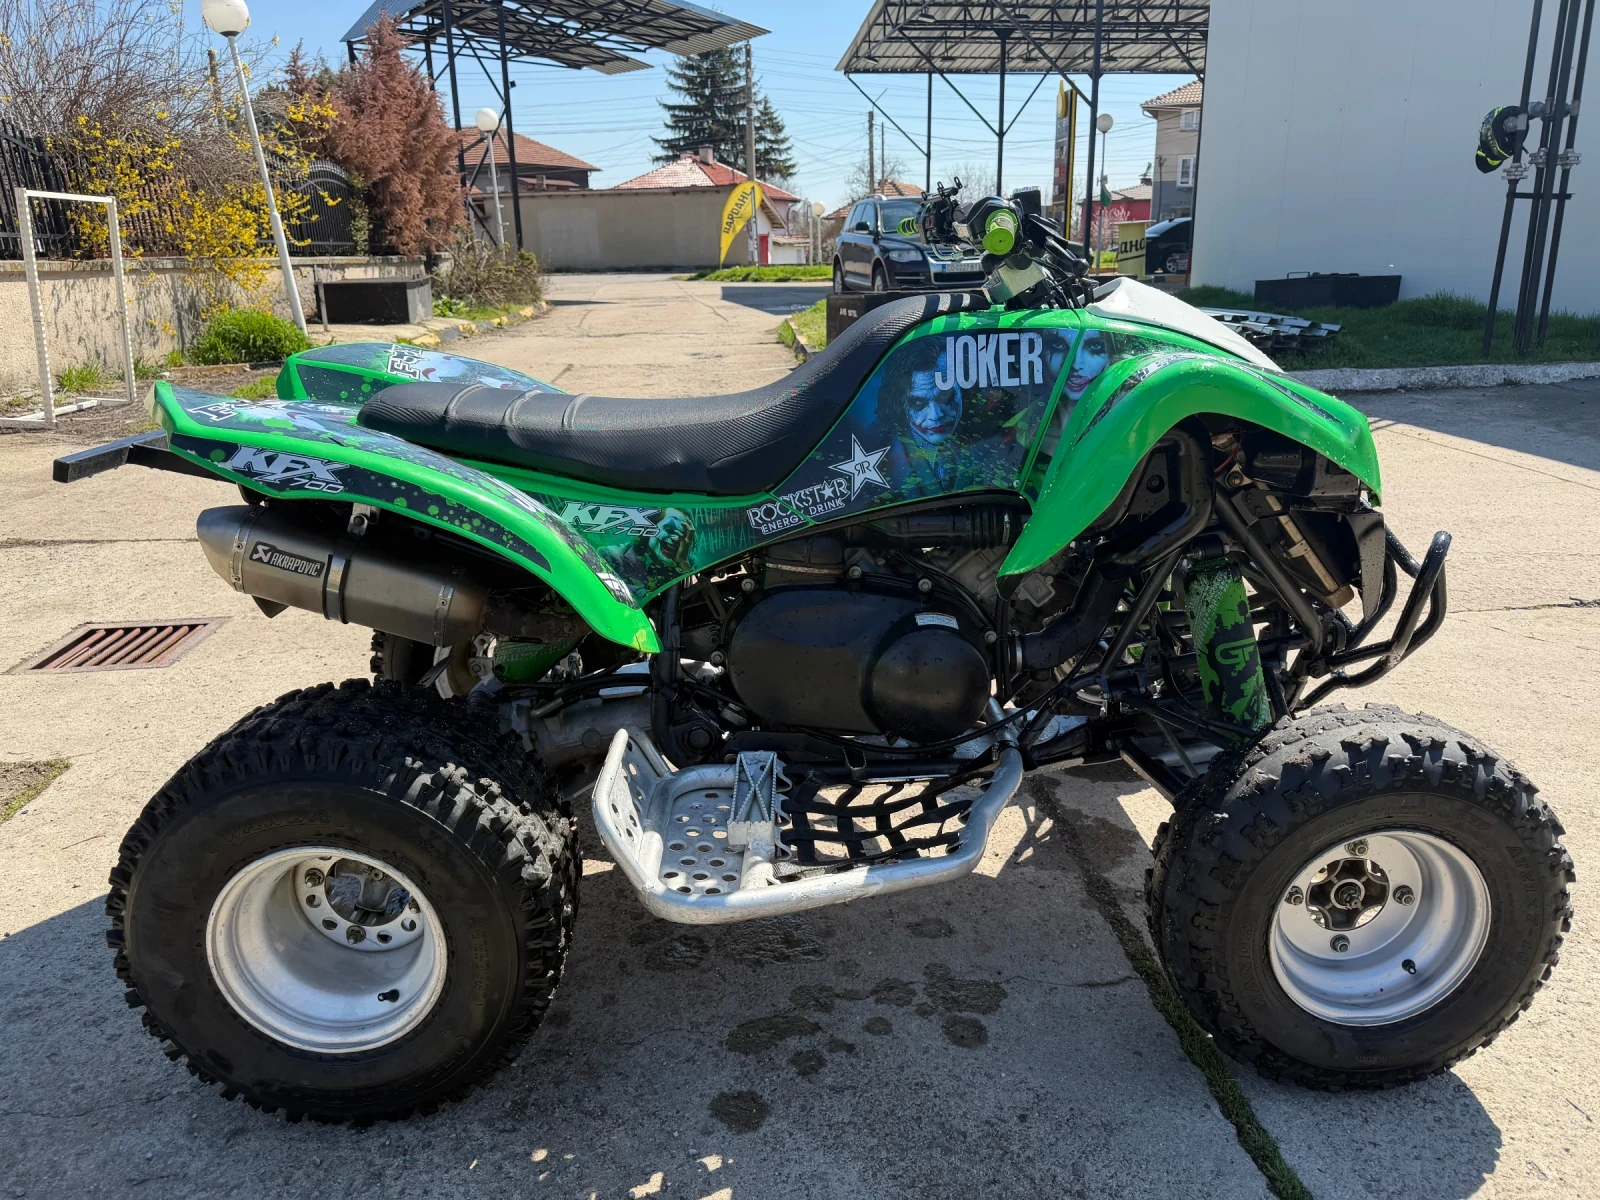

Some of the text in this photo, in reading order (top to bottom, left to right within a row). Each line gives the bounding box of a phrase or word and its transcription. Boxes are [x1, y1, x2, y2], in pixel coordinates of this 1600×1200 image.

[935, 332, 1043, 390] JOKER
[230, 444, 349, 484] KFX
[289, 478, 344, 493] 700
[560, 501, 661, 533] KFX
[809, 498, 845, 515] DRINK
[614, 526, 659, 537] 700
